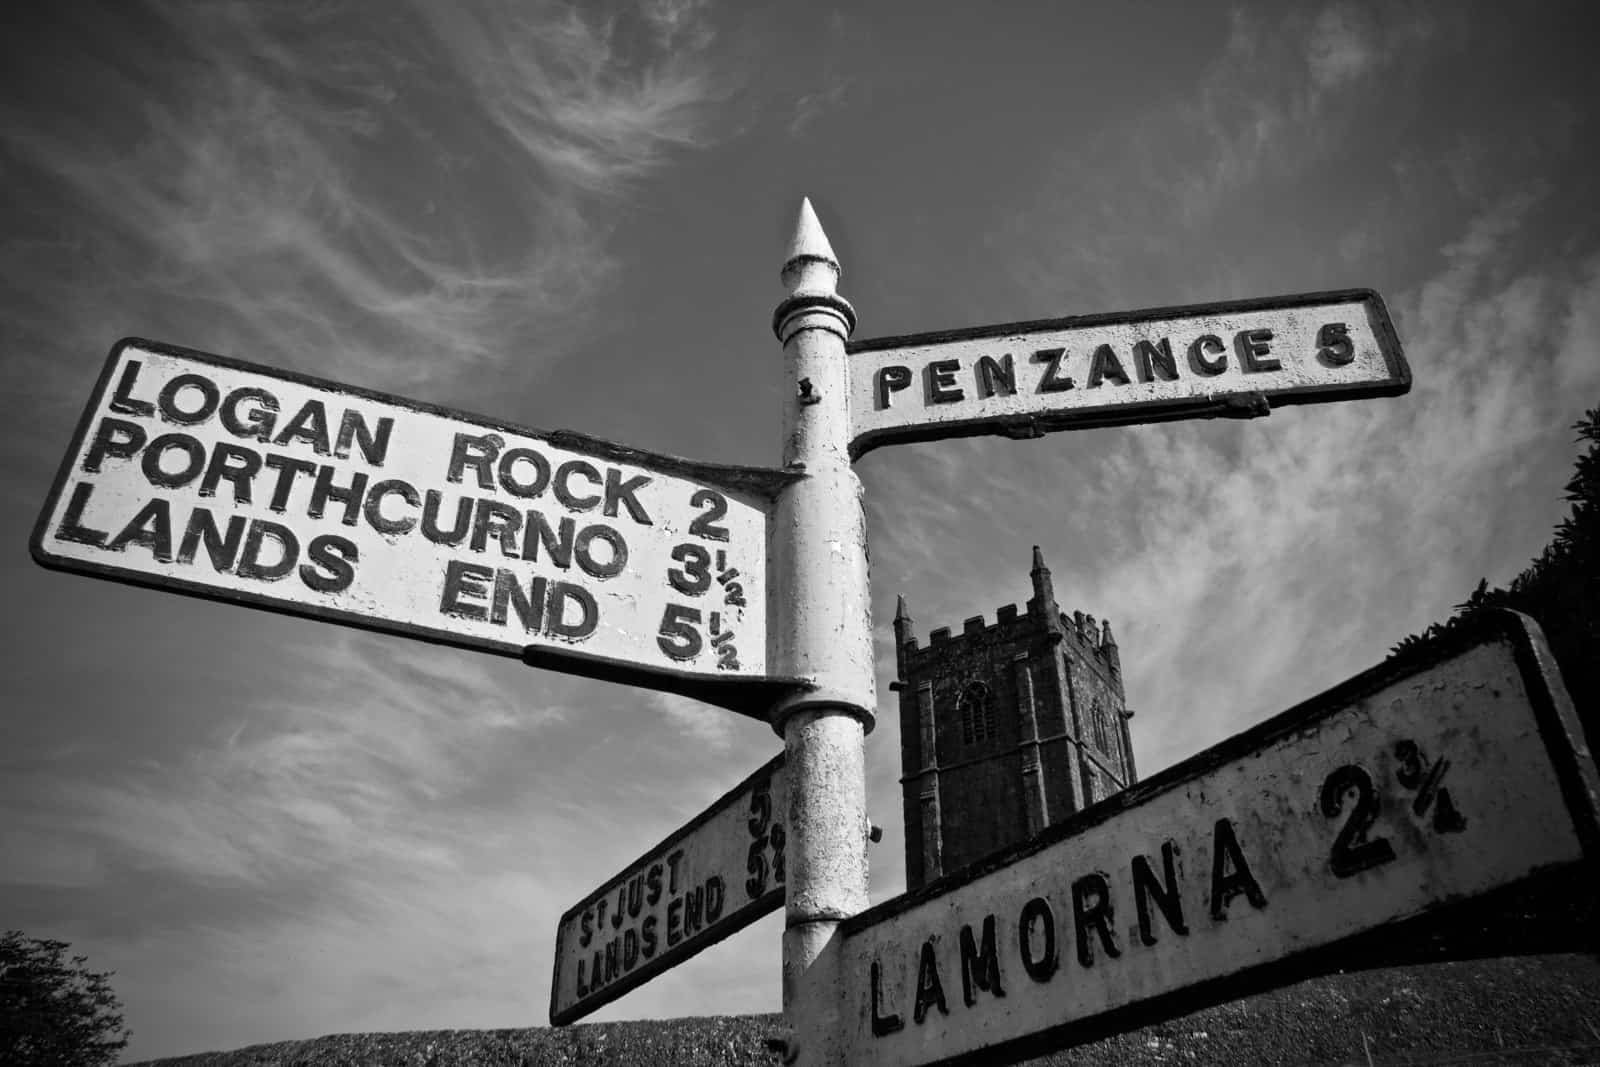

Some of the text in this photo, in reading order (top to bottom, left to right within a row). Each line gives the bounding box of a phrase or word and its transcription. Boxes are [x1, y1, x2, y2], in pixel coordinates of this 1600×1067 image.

[874, 322, 1357, 410] PENZANCE 5
[82, 416, 629, 582] PORTHCURNO
[109, 359, 730, 542] LOGAN ROCK 2
[54, 482, 360, 593] LANDS
[440, 559, 600, 643] END
[577, 916, 658, 999] LANDS
[668, 875, 725, 946] END
[580, 899, 608, 947] ST
[611, 850, 684, 929] JUST
[870, 817, 1267, 1038] LAMORNA
